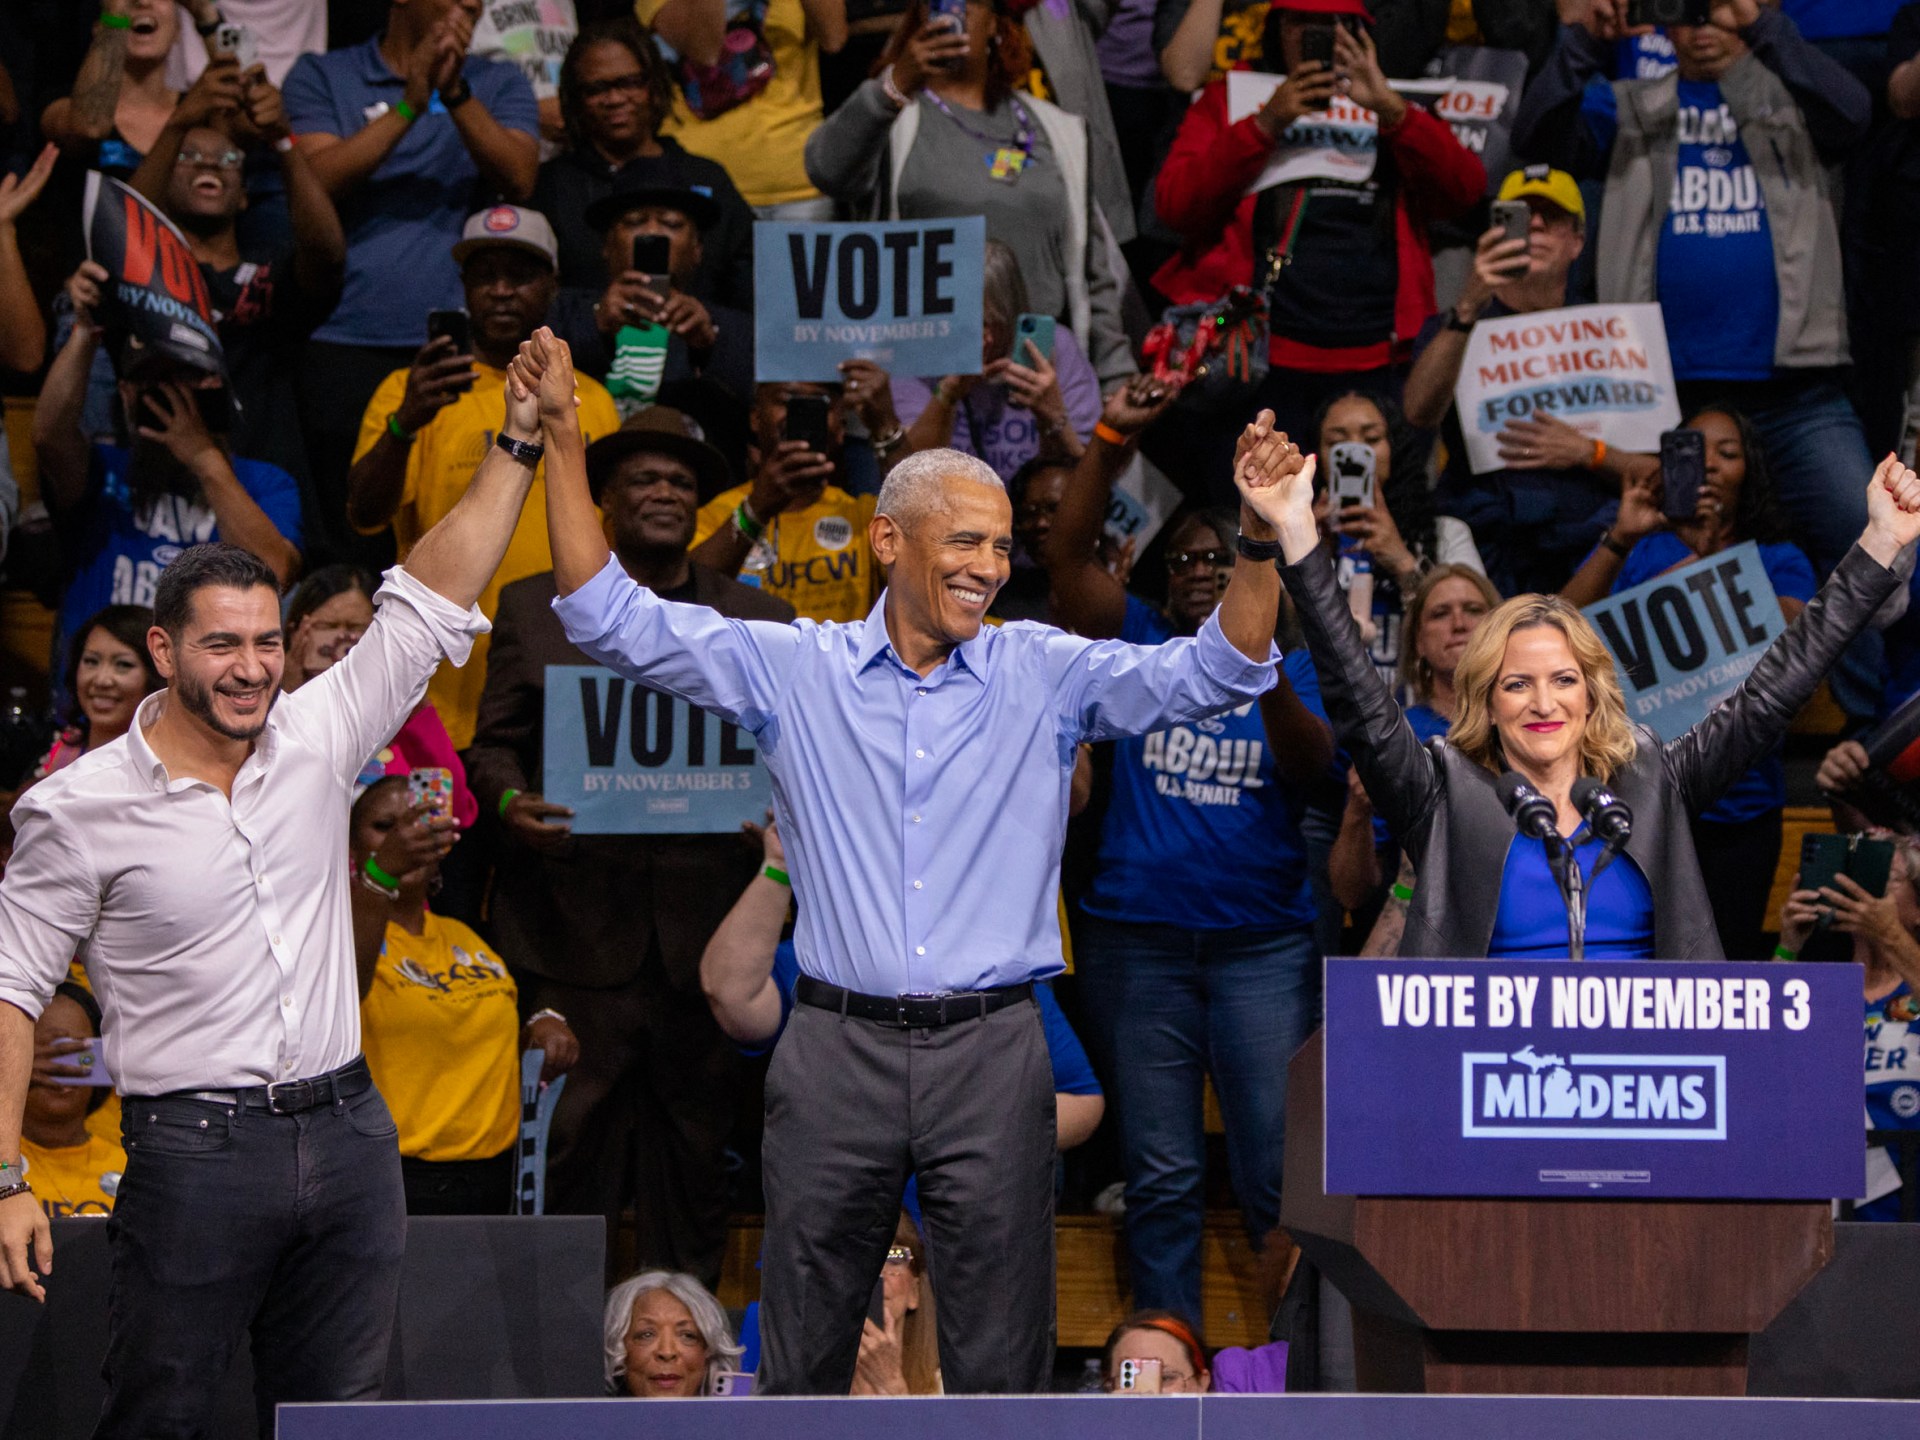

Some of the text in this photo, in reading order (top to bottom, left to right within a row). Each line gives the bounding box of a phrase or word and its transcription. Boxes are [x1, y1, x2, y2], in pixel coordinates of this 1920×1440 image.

[1673, 210, 1761, 235] U.S. SENATE
[788, 229, 955, 320] VOTE
[794, 320, 950, 343] BY NOVEMBER 3
[1489, 317, 1627, 354] MOVING
[1478, 347, 1648, 387] MICHIGAN
[1485, 381, 1655, 423] FORWARD
[768, 549, 857, 589] UFCW
[1594, 557, 1768, 692] VOTE
[1636, 692, 1663, 716] BY
[1142, 726, 1264, 788] ABDUL
[583, 772, 750, 791] BY NOVEMBER 3
[1155, 774, 1242, 806] U.S. SENATE
[1377, 974, 1811, 1031] VOTE BY NOVEMBER 3
